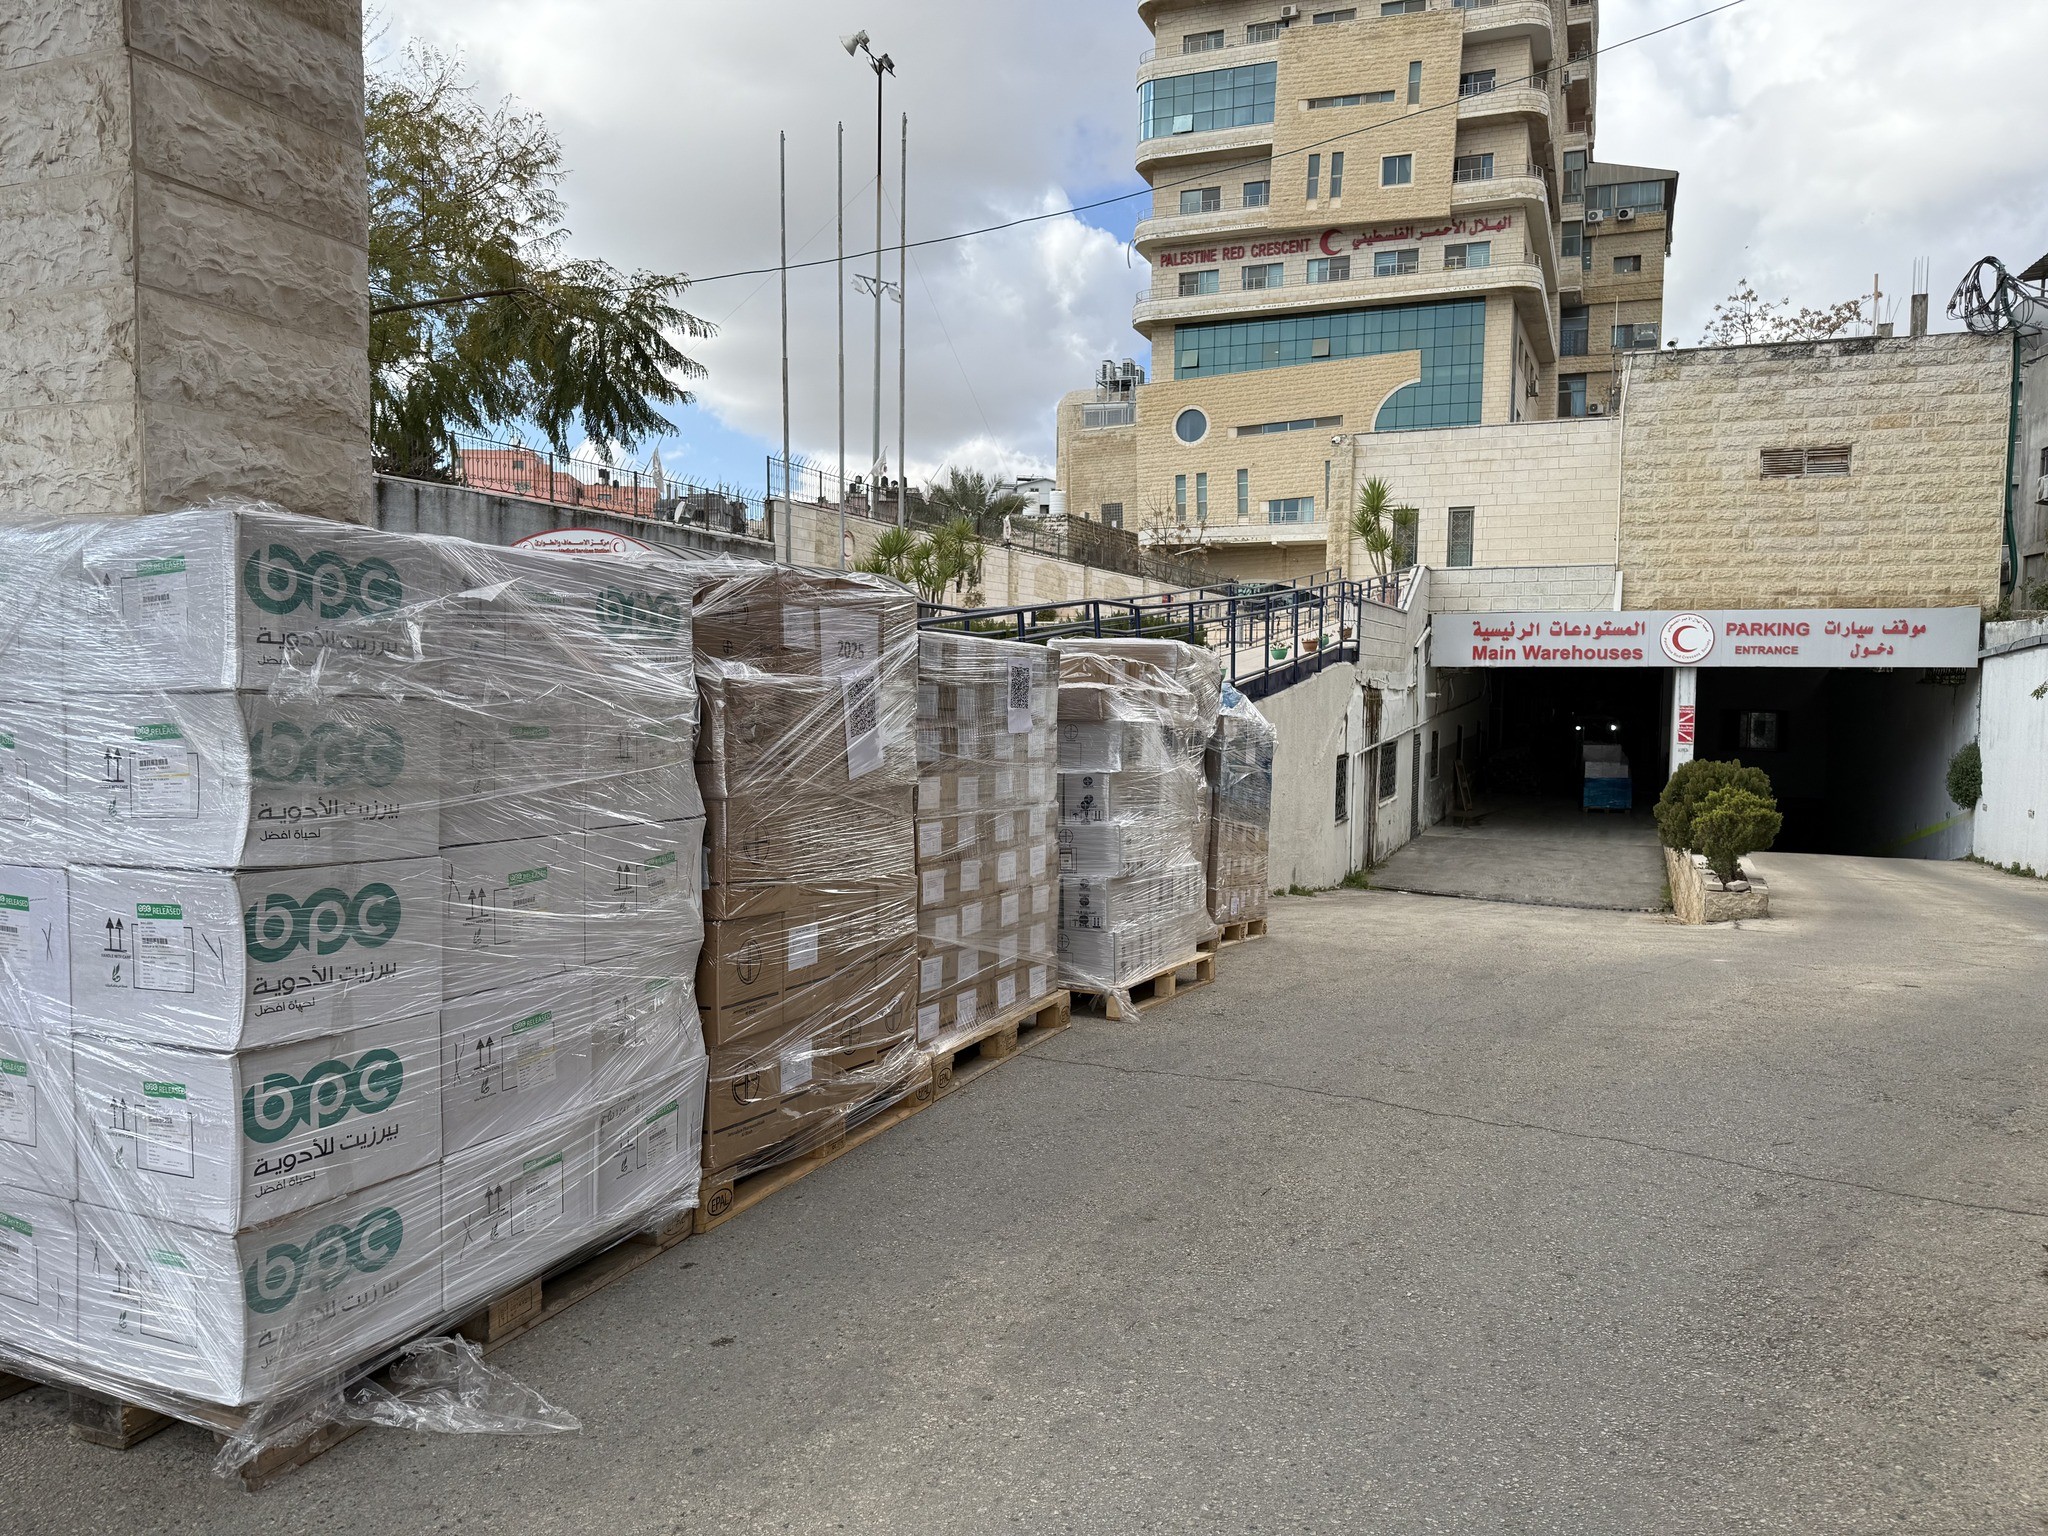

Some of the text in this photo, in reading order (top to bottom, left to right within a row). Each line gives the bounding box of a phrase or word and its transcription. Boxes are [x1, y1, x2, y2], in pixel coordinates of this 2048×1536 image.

[1352, 215, 1512, 250] الهلال الأحمر الفلسطيني
[1160, 238, 1311, 267] PALESTINE RED CRESCENT
[245, 545, 401, 618] bpc
[1472, 621, 1540, 641] الرئيسية
[1550, 621, 1646, 640] المستودعات
[1726, 622, 1810, 636] PARKING
[1824, 620, 1926, 638] موقف سيارات
[837, 640, 865, 660] 2025
[1472, 646, 1643, 660] Main Warehouses
[1735, 646, 1799, 655] ENTRANCE
[1850, 642, 1894, 658] دخول
[151, 728, 180, 736] RELEAS
[250, 721, 404, 787] bpc
[260, 829, 320, 842] لحياة افضل
[6, 898, 28, 907] RELEASED
[152, 908, 180, 916] RELEASED
[245, 884, 400, 962] bpc
[339, 962, 396, 983] بيرزيت
[255, 997, 315, 1017] لحياة افضل
[527, 1013, 552, 1027] RELEASED
[159, 1086, 186, 1094] RELEASED
[244, 1049, 402, 1142] bpc
[254, 1124, 398, 1176] بيرزيت للأدوية
[255, 1171, 316, 1198] لحياة افضل
[712, 1193, 728, 1212] EPAL
[245, 1208, 402, 1313] bpc
